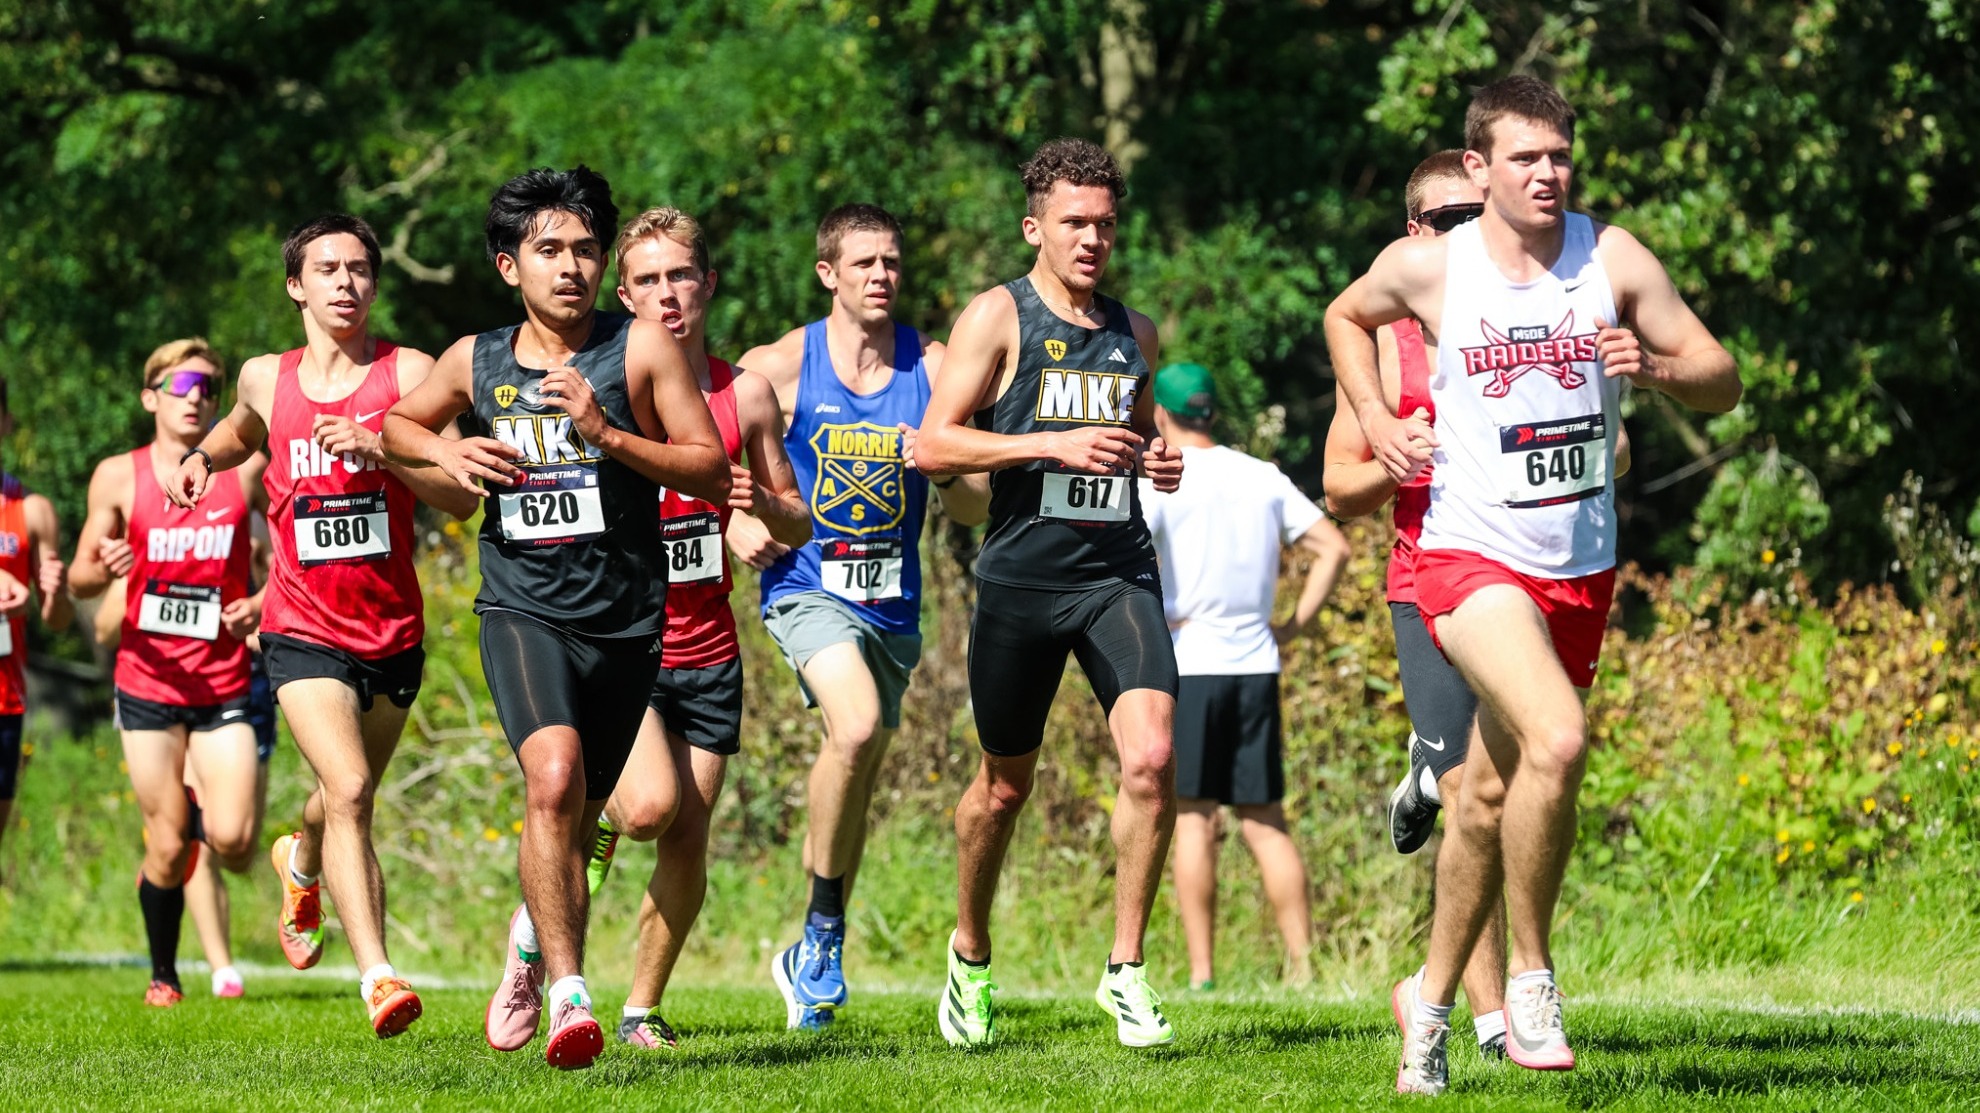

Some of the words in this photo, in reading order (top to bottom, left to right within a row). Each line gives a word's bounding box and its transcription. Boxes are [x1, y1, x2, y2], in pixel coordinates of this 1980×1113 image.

[1459, 333, 1598, 376] RAIDERS
[1036, 368, 1139, 426] MKE
[493, 412, 605, 466] MK
[827, 429, 899, 458] NORRIE
[1535, 421, 1590, 437] PRIMETIME
[528, 469, 581, 481] PRIMETIME
[1526, 445, 1585, 487] 640
[529, 479, 557, 487] TIMING
[820, 477, 837, 497] A
[881, 480, 897, 498] C
[1067, 476, 1114, 509] 617
[322, 496, 372, 509] PRIMETIME
[520, 491, 580, 527] 620
[850, 503, 866, 521] S
[314, 516, 370, 548] 680
[663, 518, 707, 532] PRIMETIME
[147, 523, 235, 563] RIPON
[842, 560, 882, 589] 702
[160, 599, 200, 625] 681
